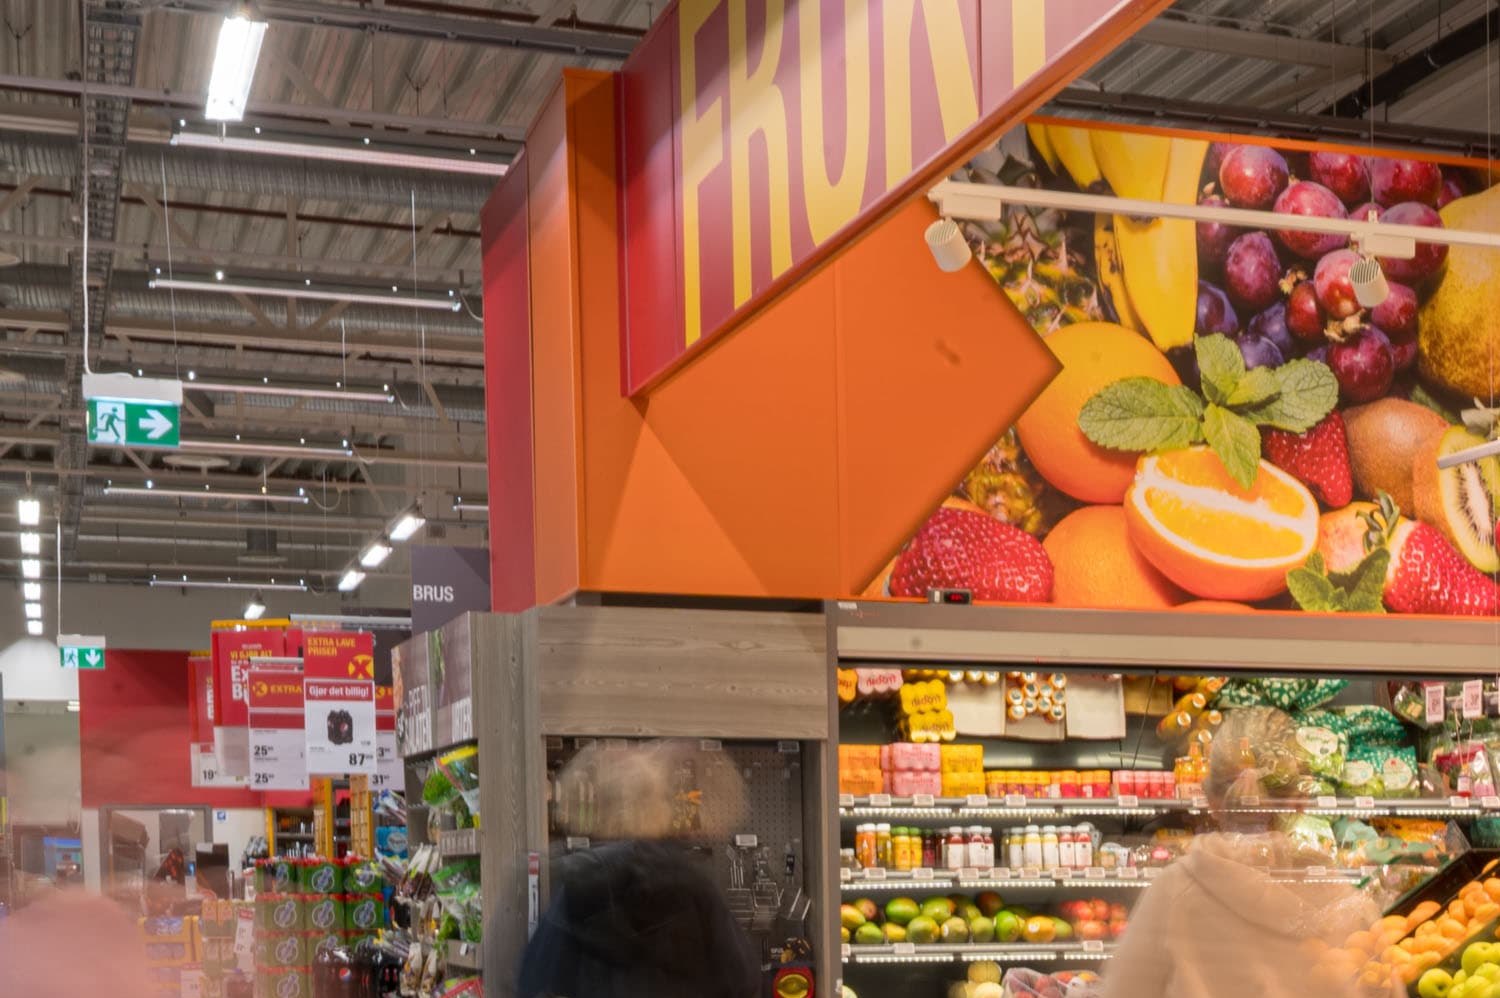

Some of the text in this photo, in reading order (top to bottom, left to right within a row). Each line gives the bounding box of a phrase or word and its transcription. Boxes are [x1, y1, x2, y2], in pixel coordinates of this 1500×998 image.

[413, 584, 454, 602] BRUS
[309, 685, 369, 697] Gjør det billig!
